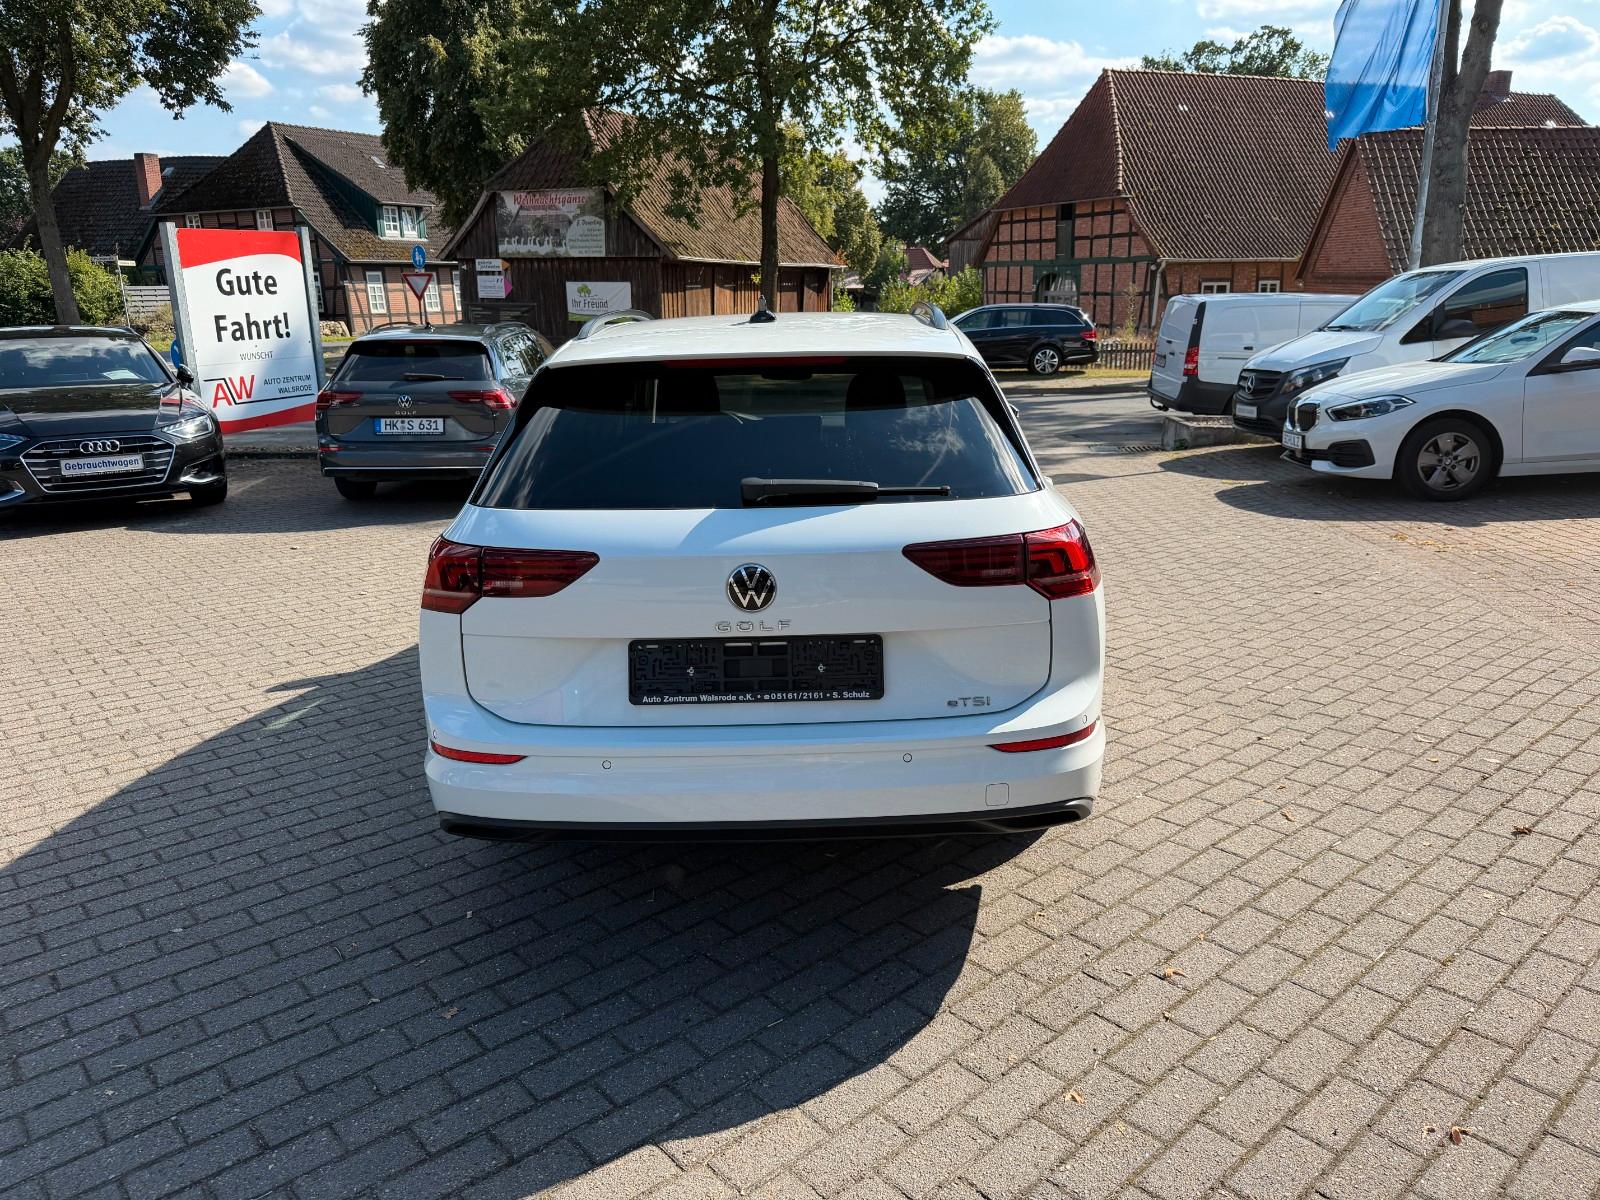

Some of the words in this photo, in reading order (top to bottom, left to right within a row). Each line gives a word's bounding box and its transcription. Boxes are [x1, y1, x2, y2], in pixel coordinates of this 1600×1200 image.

[215, 267, 278, 296] Gute
[571, 298, 581, 308] Ihr
[583, 298, 609, 309] Freund
[213, 312, 291, 342] Fahrt!
[263, 377, 282, 386] AUTO
[282, 374, 312, 384] ZENTRUM
[278, 384, 313, 394] WALSRODE
[384, 419, 399, 431] HK
[406, 419, 415, 431] S
[418, 419, 440, 431] 631
[64, 457, 140, 471] Gebrauchtwagen
[714, 619, 791, 633] GOLF
[642, 695, 661, 703] Auto
[663, 695, 698, 703] Zentrum
[699, 693, 737, 702] Walsrode
[738, 693, 755, 701] e.K.
[832, 691, 841, 699] S.
[843, 690, 870, 698] Schulz
[946, 695, 991, 707] eTSI
